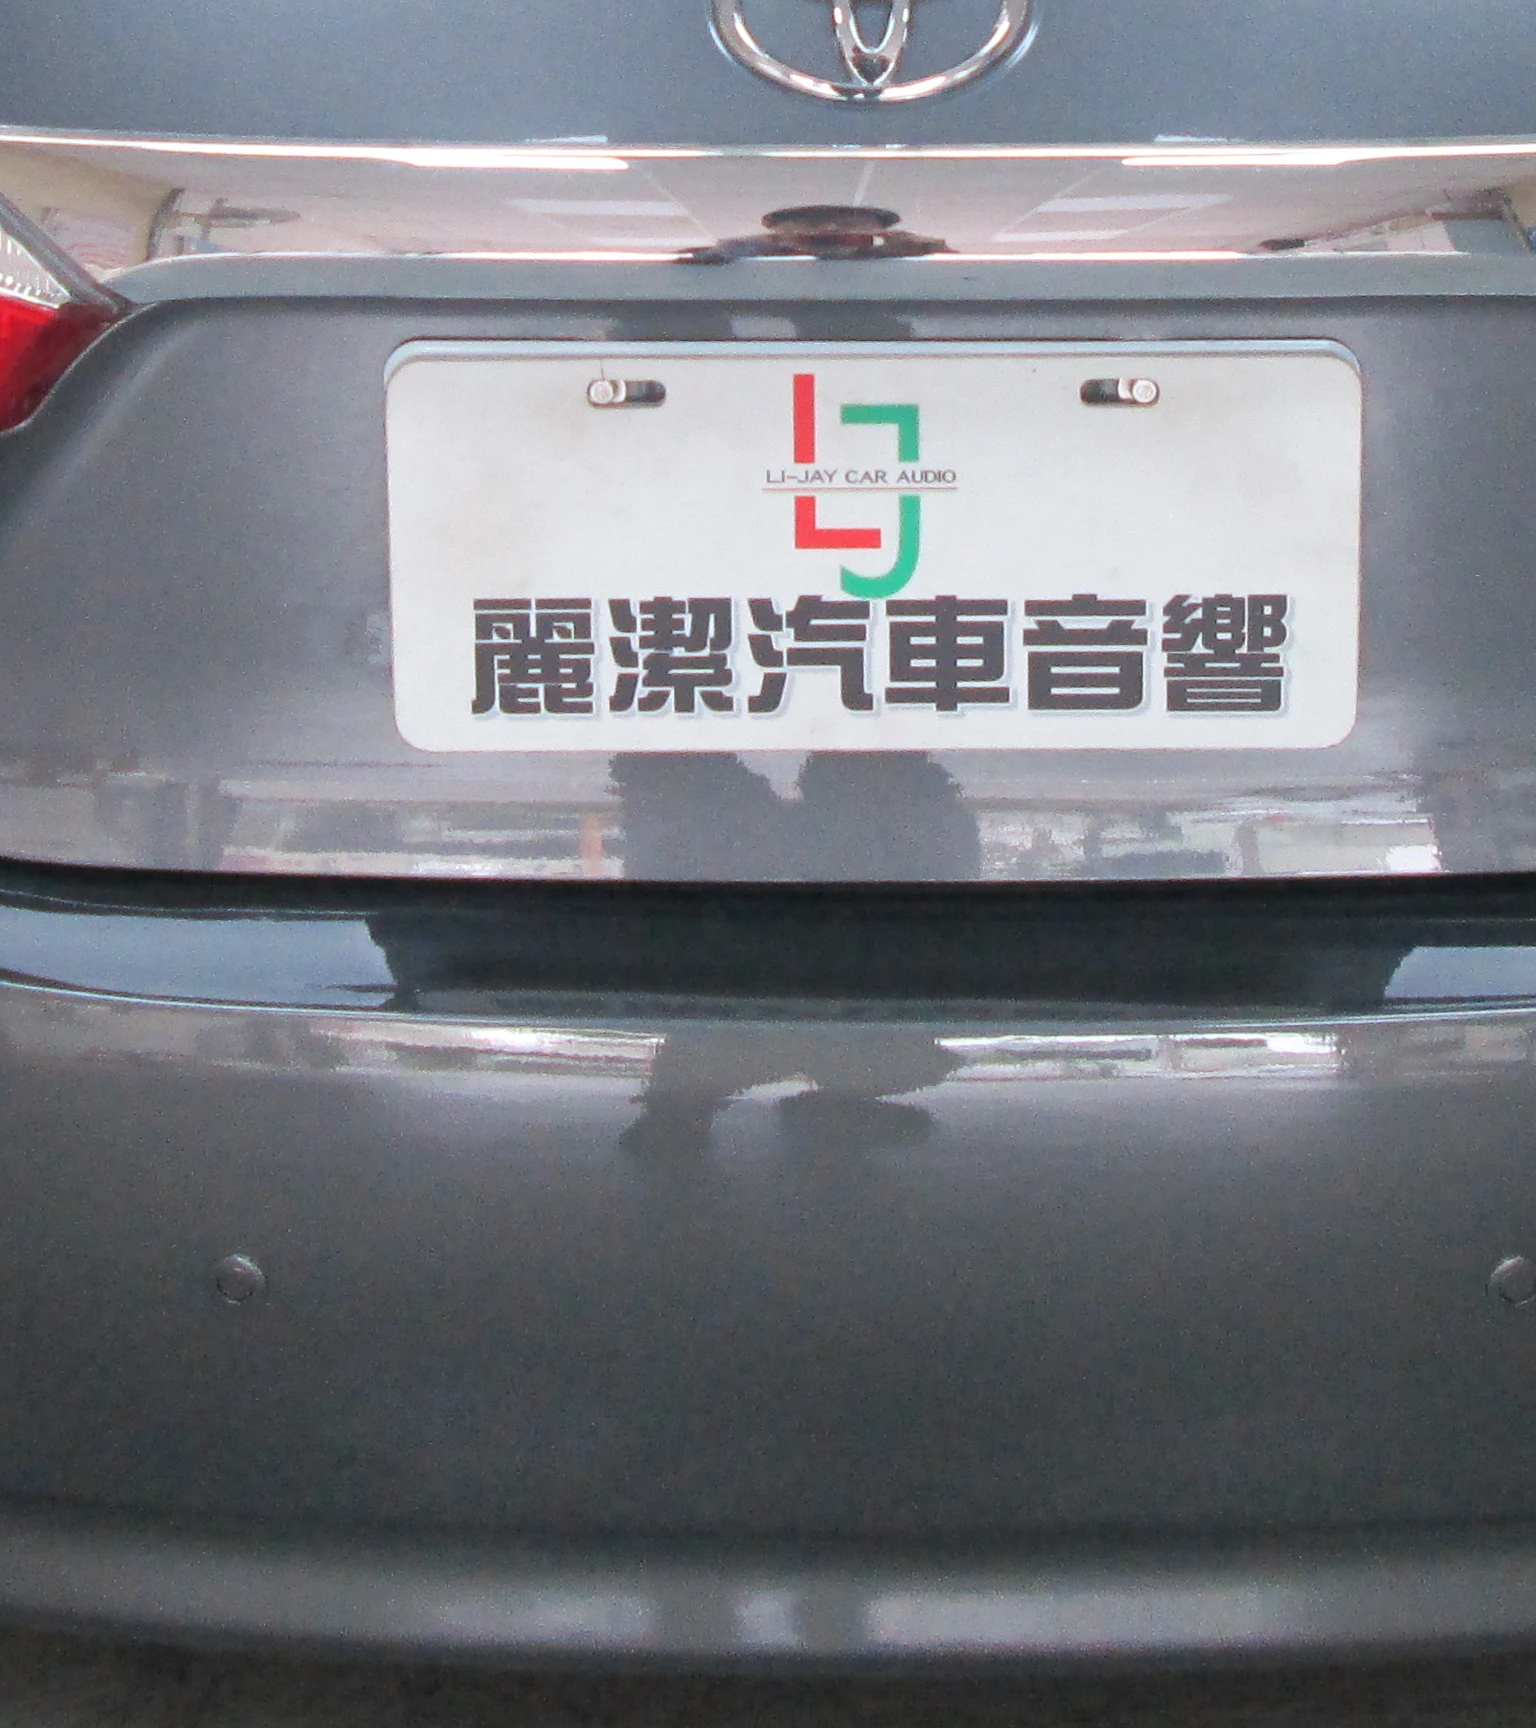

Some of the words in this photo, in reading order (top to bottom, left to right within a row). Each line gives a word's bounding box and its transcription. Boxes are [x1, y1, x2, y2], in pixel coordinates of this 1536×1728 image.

[766, 469, 838, 484] LI-JAY
[845, 469, 887, 484] CAR
[896, 469, 957, 484] AUDIO
[472, 592, 1289, 715] 麗潔汽車音響
